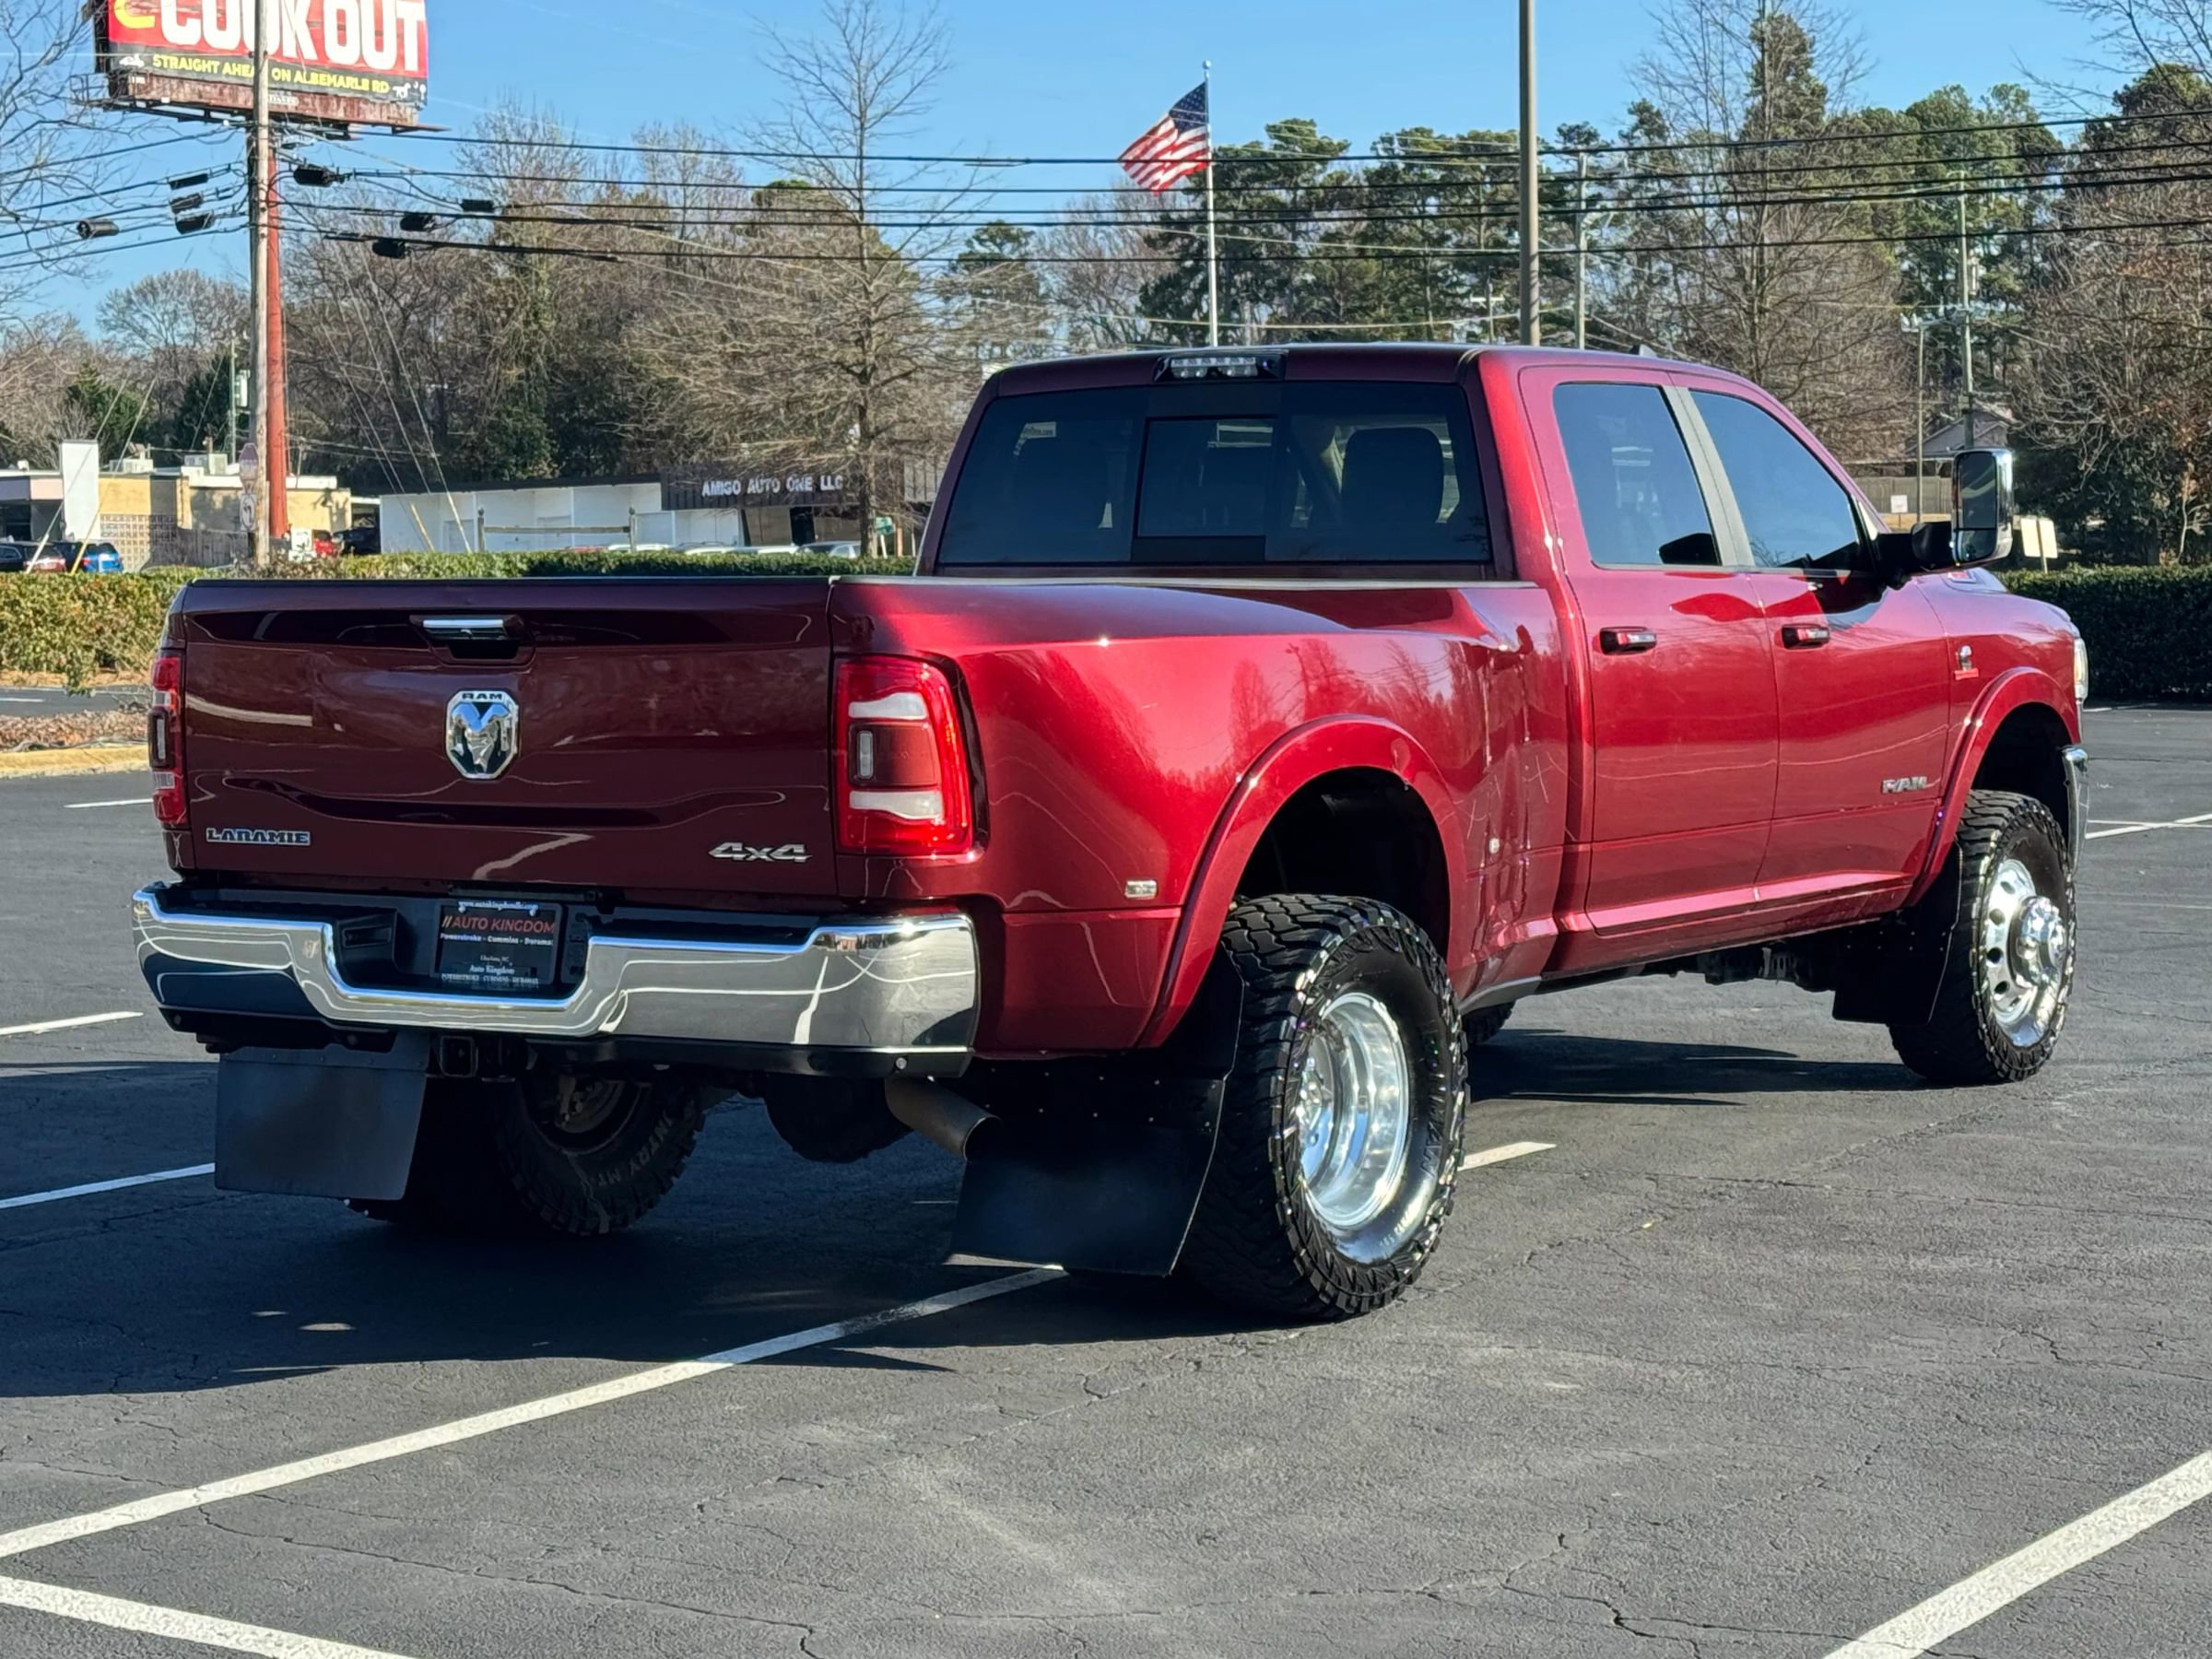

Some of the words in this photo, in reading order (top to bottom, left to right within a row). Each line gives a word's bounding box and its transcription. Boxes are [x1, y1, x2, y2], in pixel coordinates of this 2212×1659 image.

[160, 0, 318, 60] COOK
[324, 0, 426, 72] OUT
[152, 53, 220, 74] STRAIGHT
[221, 62, 255, 78] AHE
[271, 67, 291, 82] ON
[293, 70, 371, 90] ALBEMARLE
[371, 80, 390, 93] RD
[701, 480, 741, 497] AMIGO
[747, 477, 781, 494] AUTO
[785, 476, 813, 491] ONE
[819, 474, 843, 490] LLC
[1882, 776, 1927, 794] RAM
[206, 828, 311, 846] LARAMIE
[490, 919, 555, 934] KINGDOM
